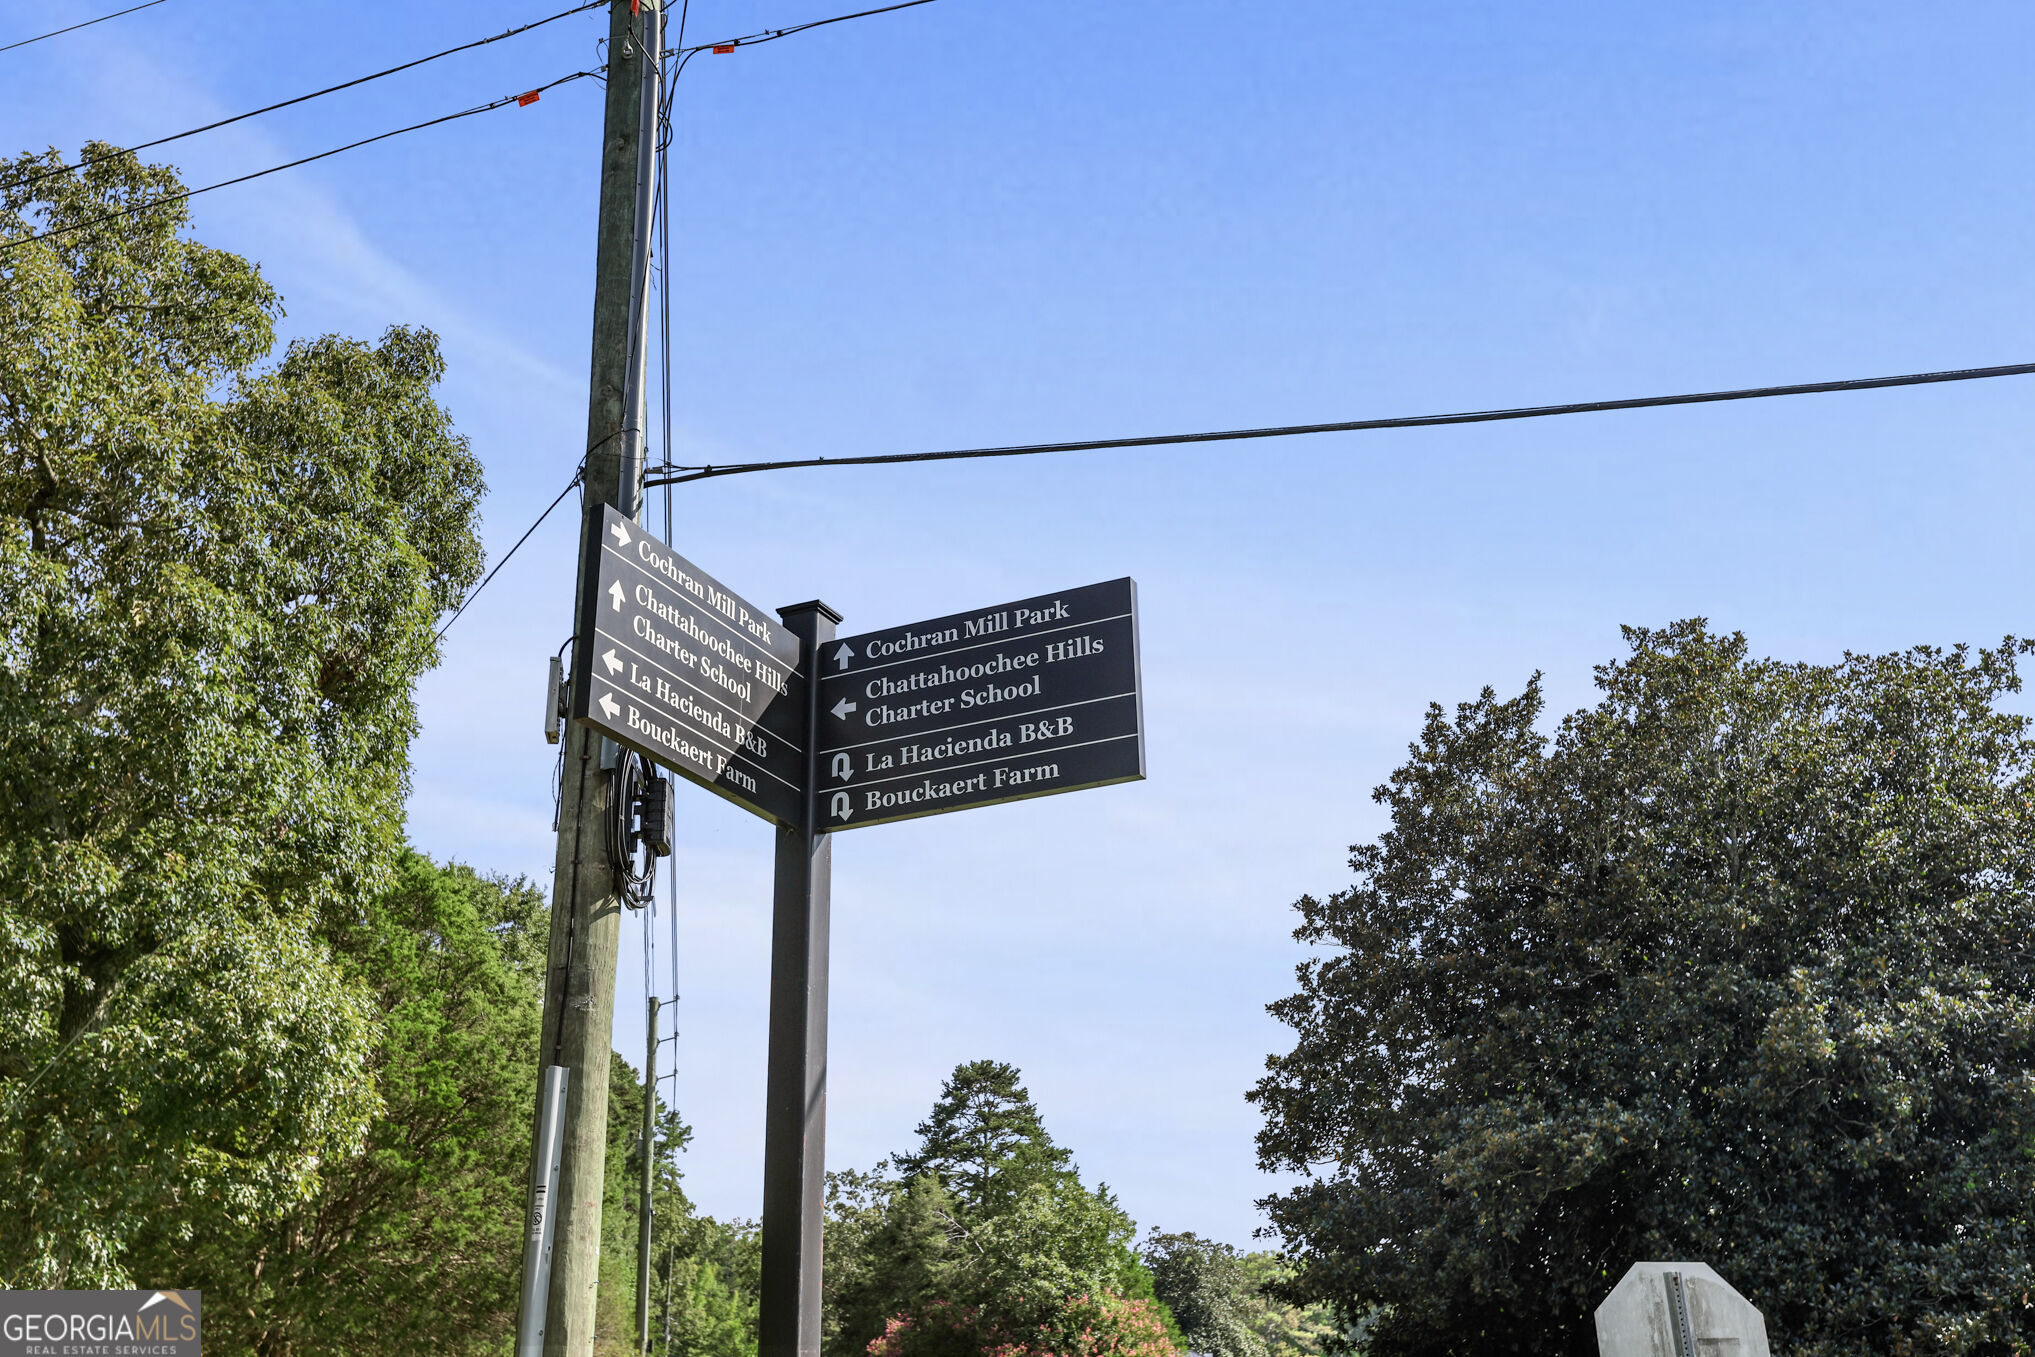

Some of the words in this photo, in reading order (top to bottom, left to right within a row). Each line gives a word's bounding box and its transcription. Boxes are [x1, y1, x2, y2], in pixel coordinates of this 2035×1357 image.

[638, 540, 704, 600] Cochran
[707, 587, 736, 621] Mill
[738, 606, 772, 645] Park
[866, 628, 958, 659] Cochran
[964, 612, 1009, 639] Mill
[1014, 600, 1070, 628] Park
[633, 615, 697, 668] Charter
[700, 657, 751, 702] School
[636, 584, 752, 673] Chattahoochee
[755, 660, 788, 696] Hills
[866, 650, 1039, 699] Chattahoochee
[1045, 635, 1104, 663] Hills
[630, 662, 651, 690] La
[656, 679, 731, 739] Hacienda
[735, 724, 767, 759] B&B
[865, 697, 955, 727] Charter
[960, 675, 1041, 709] School
[627, 705, 713, 770] Bouckaert
[716, 753, 757, 794] Farm
[866, 752, 893, 772] La
[900, 727, 1011, 766] Hacienda
[1019, 716, 1074, 744] B&B
[865, 772, 986, 811] Bouckaert
[993, 763, 1059, 786] Farm
